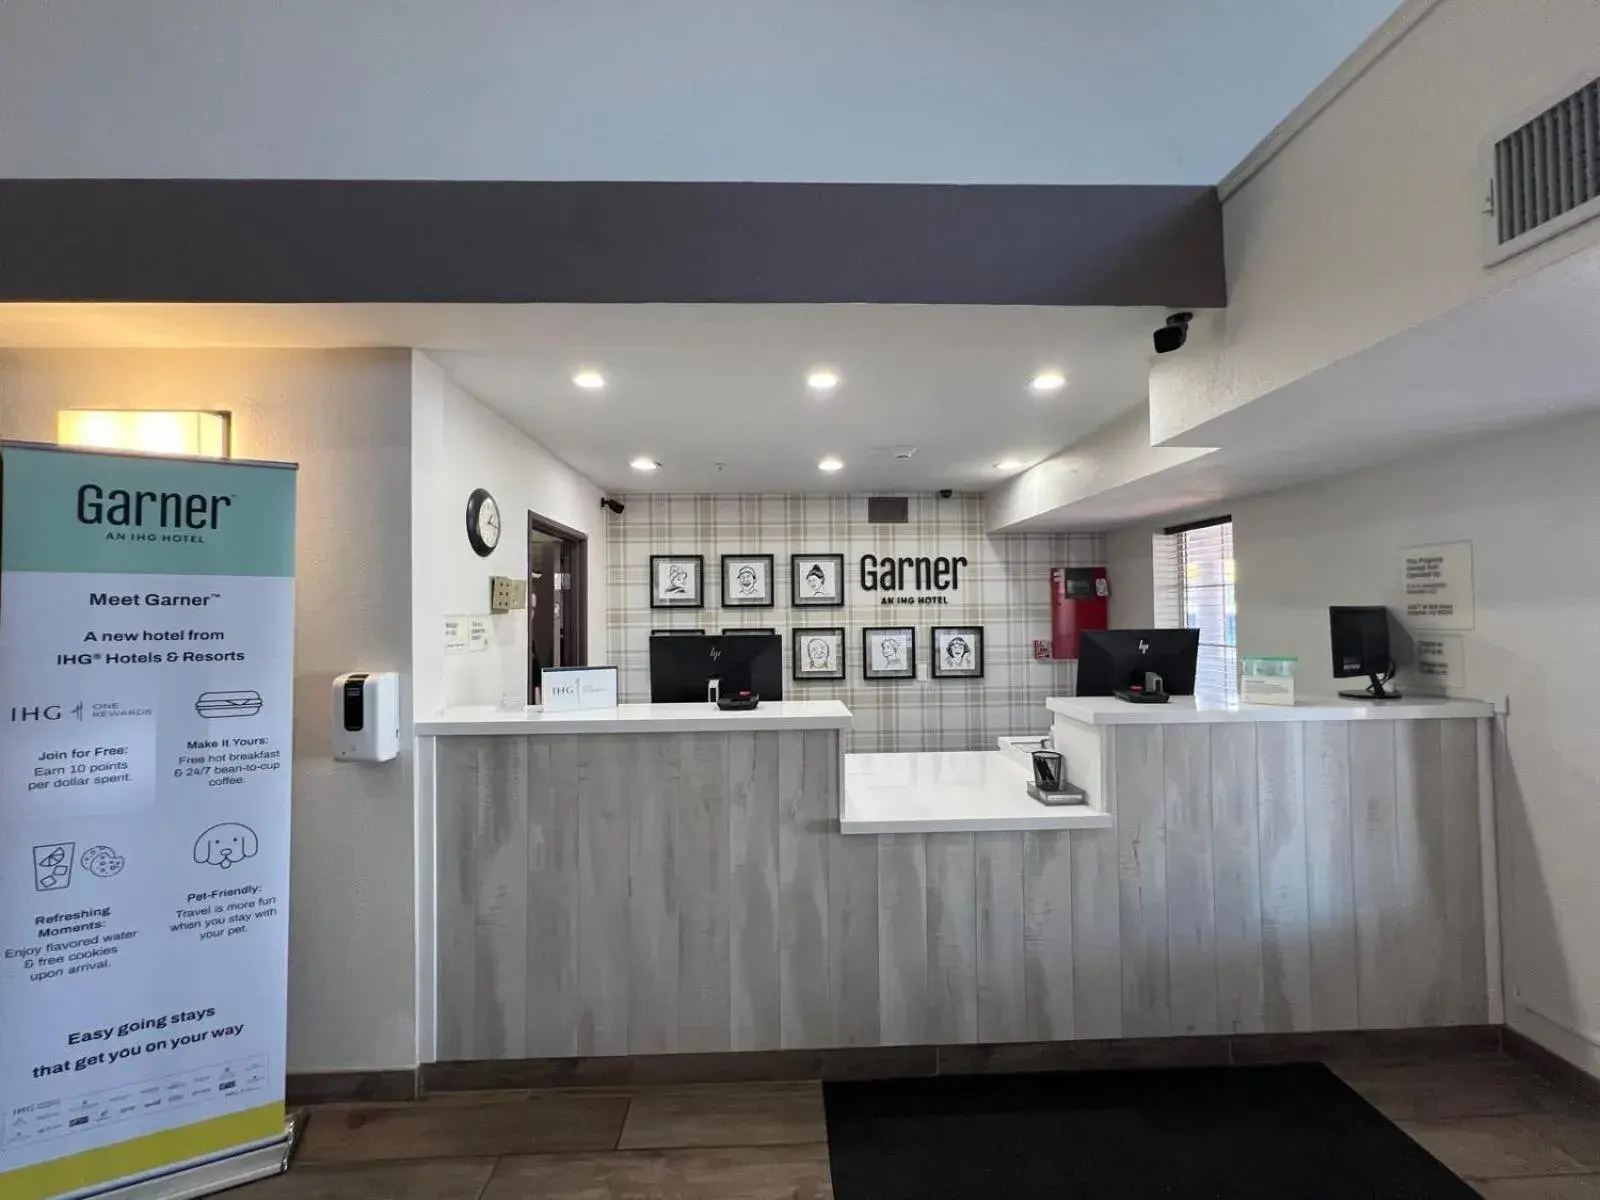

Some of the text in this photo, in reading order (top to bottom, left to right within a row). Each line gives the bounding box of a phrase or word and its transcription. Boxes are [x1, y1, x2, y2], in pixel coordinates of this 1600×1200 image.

[106, 532, 204, 544] AN IHG HOTEL
[860, 554, 968, 591] Garner
[89, 593, 140, 607] Meet
[881, 596, 948, 605] AN IHG HOTEL
[83, 630, 224, 643] A new hotel from
[106, 652, 162, 664] Hotels
[167, 652, 179, 663] &
[183, 651, 245, 663] Resorts
[552, 685, 574, 696] IHG
[11, 705, 62, 722] IHG
[92, 702, 120, 710] ONE
[92, 709, 152, 718] REWARDS
[187, 740, 218, 750] Make
[233, 737, 269, 747] Yours:
[38, 746, 129, 761] Join for Free:
[178, 750, 281, 765] Free hot breakfast
[34, 761, 128, 777] Earn 10 points
[174, 761, 281, 777] & 24/7 bean-to-cup
[28, 773, 132, 792] per dollar spent.
[208, 777, 246, 787] coffee.
[187, 885, 263, 903] Pet-Friendly:
[176, 896, 276, 919] Travel is more fun
[35, 906, 111, 926] Refreshing
[170, 908, 277, 932] when you stay with
[38, 921, 107, 939] Moments:
[199, 925, 248, 941] your pet.
[4, 930, 139, 959] Enjoy flavored water
[23, 946, 118, 969] & free cookies
[30, 959, 111, 982] upon arrival.
[67, 1006, 215, 1046] Easy going stays
[32, 1023, 245, 1079] that get you on your way
